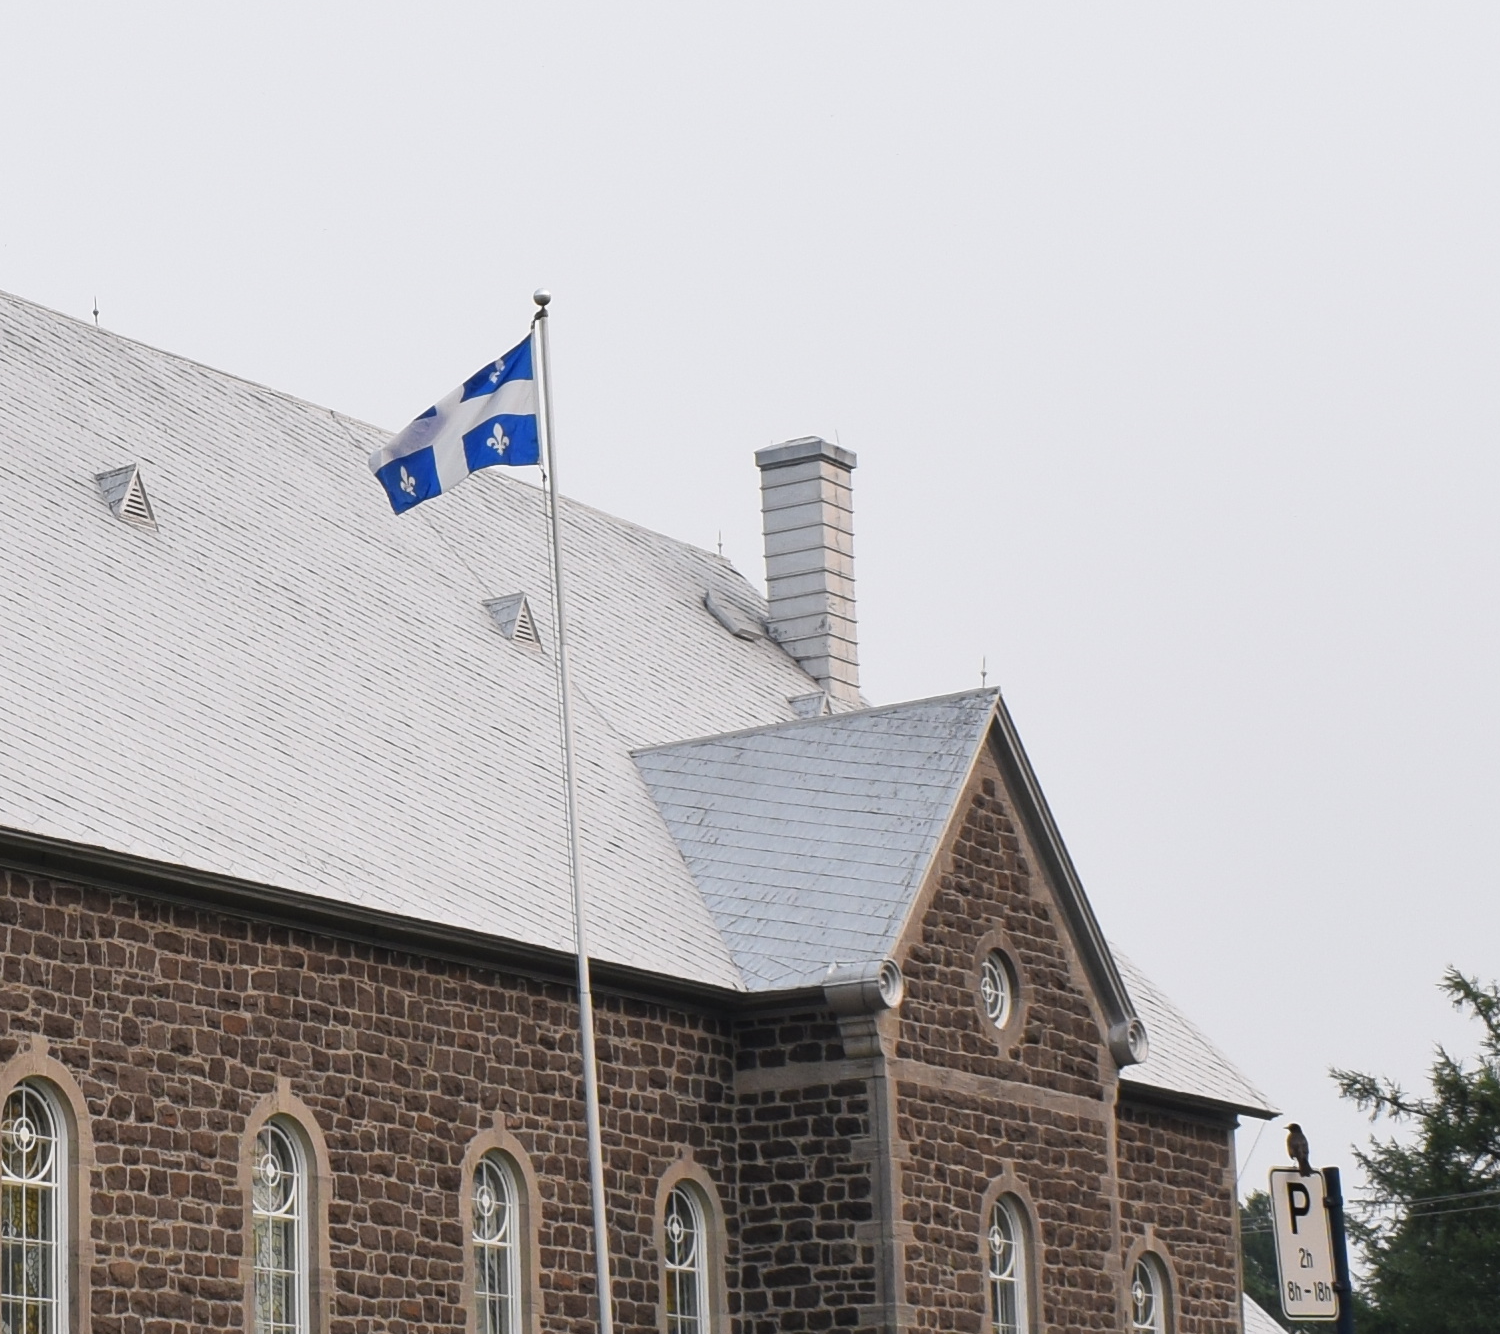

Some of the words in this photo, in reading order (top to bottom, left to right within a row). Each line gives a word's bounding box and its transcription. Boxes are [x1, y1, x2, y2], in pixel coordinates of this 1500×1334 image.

[1286, 1182, 1310, 1234] P
[1298, 1248, 1313, 1268] 2h
[1287, 1281, 1301, 1302] 8h
[1313, 1282, 1332, 1302] 18h
